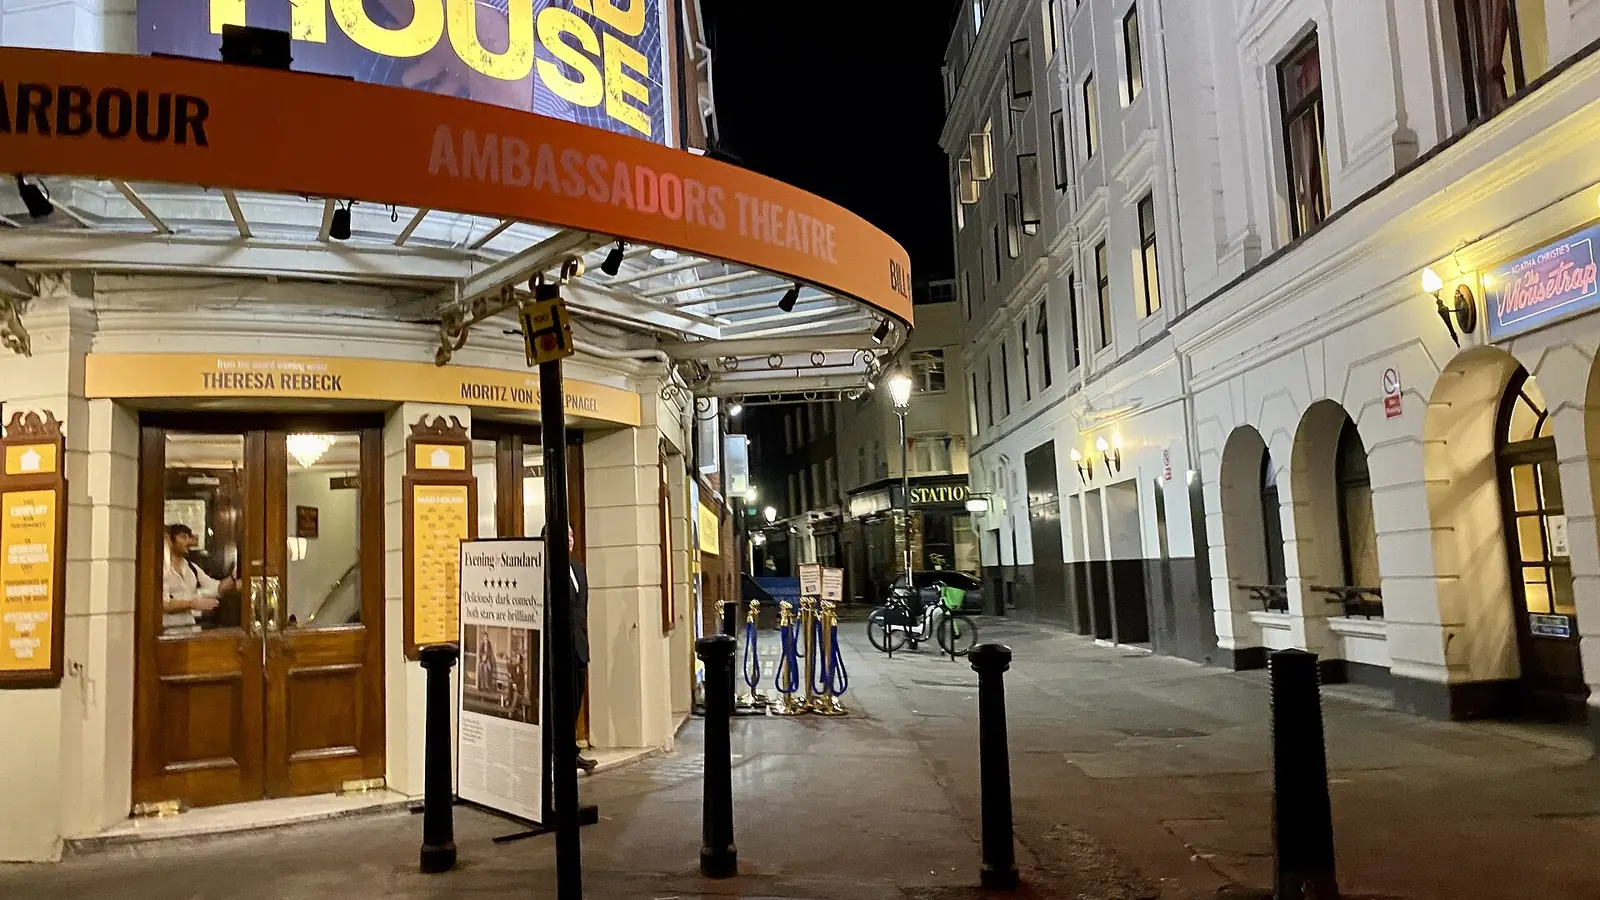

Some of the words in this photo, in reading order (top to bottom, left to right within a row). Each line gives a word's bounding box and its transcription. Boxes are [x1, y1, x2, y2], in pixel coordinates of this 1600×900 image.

[428, 123, 727, 231] AMBASSADORS
[735, 191, 838, 265] THEATRE
[1511, 258, 1536, 274] AGATHA
[1537, 243, 1570, 264] CHRISTIE'S
[1524, 269, 1540, 288] The
[1497, 261, 1597, 318] Mousetrap
[202, 372, 275, 389] THERESA
[280, 373, 342, 392] REBECK
[461, 383, 507, 401] MORITZ
[510, 387, 533, 404] VON
[464, 551, 494, 571] Evening
[501, 551, 542, 568] Standard
[495, 592, 511, 605] dark
[480, 609, 495, 620] stars
[496, 610, 506, 621] are
